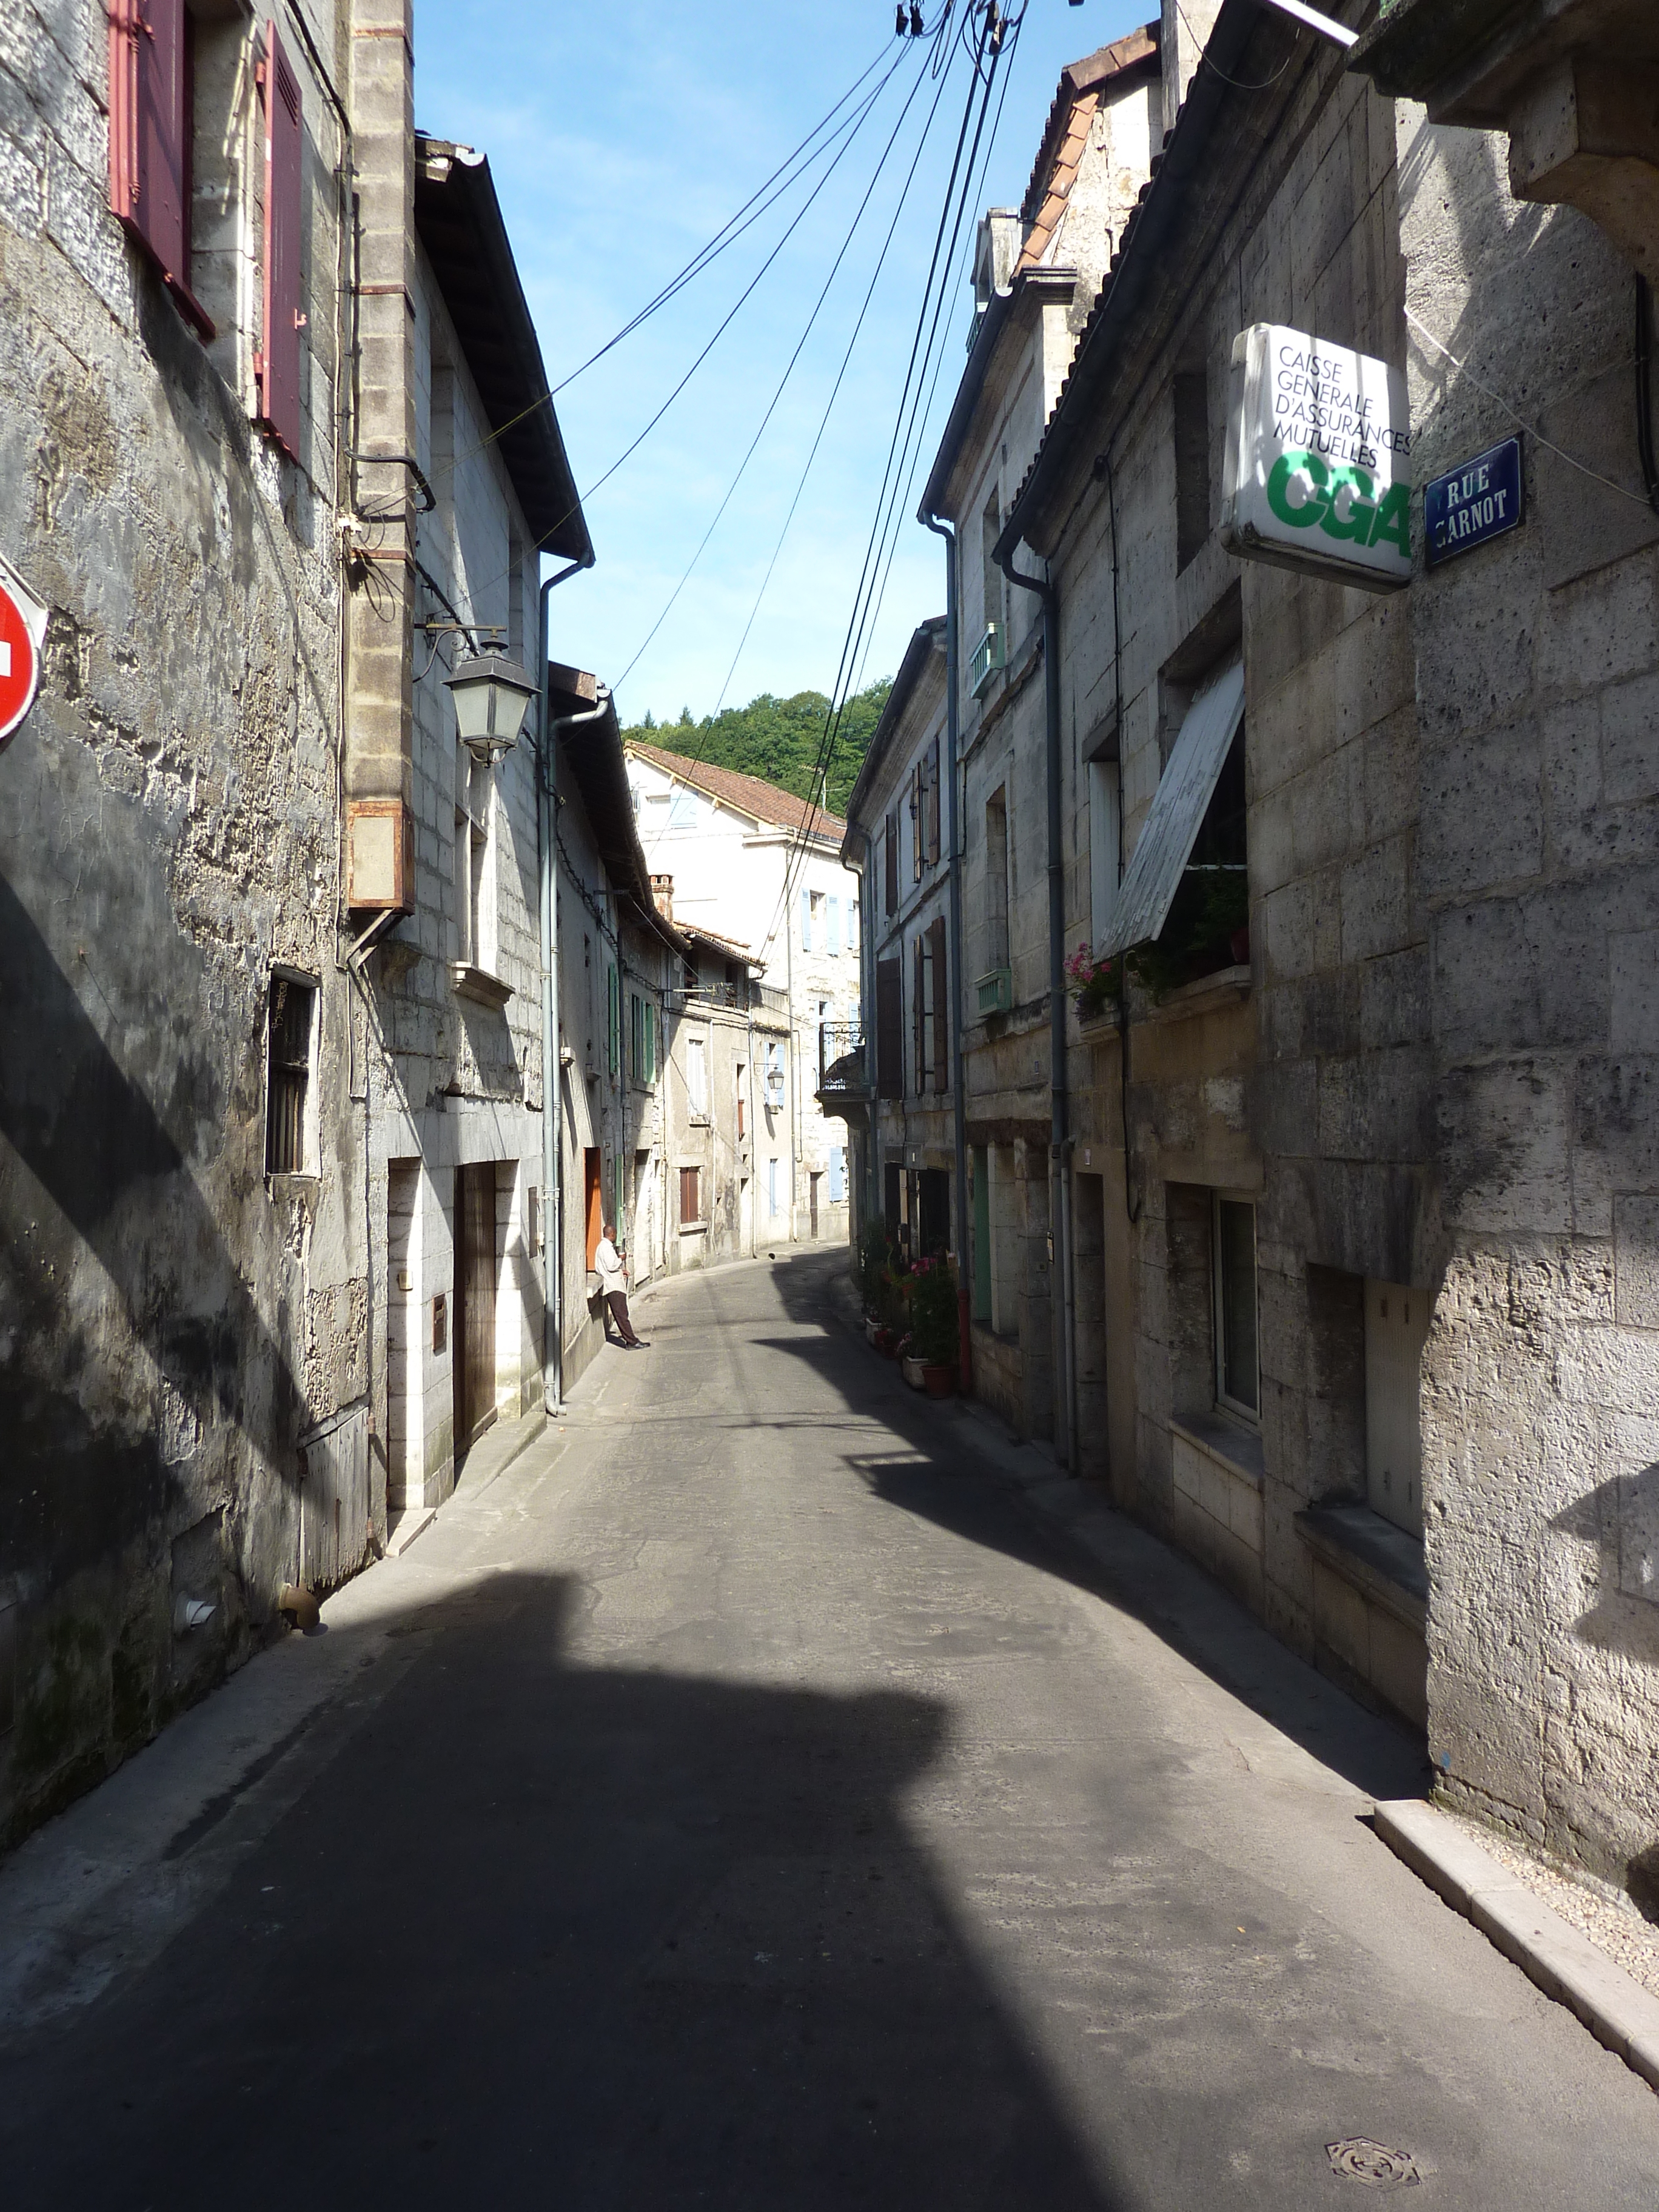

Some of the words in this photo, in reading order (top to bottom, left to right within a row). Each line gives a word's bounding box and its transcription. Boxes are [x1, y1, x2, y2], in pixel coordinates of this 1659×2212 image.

[1279, 346, 1343, 383] CAISSE
[1278, 370, 1374, 418] GENERALE
[1273, 419, 1379, 469] MUTUELLES
[1267, 451, 1412, 558] CGA
[1447, 463, 1490, 509] RUE
